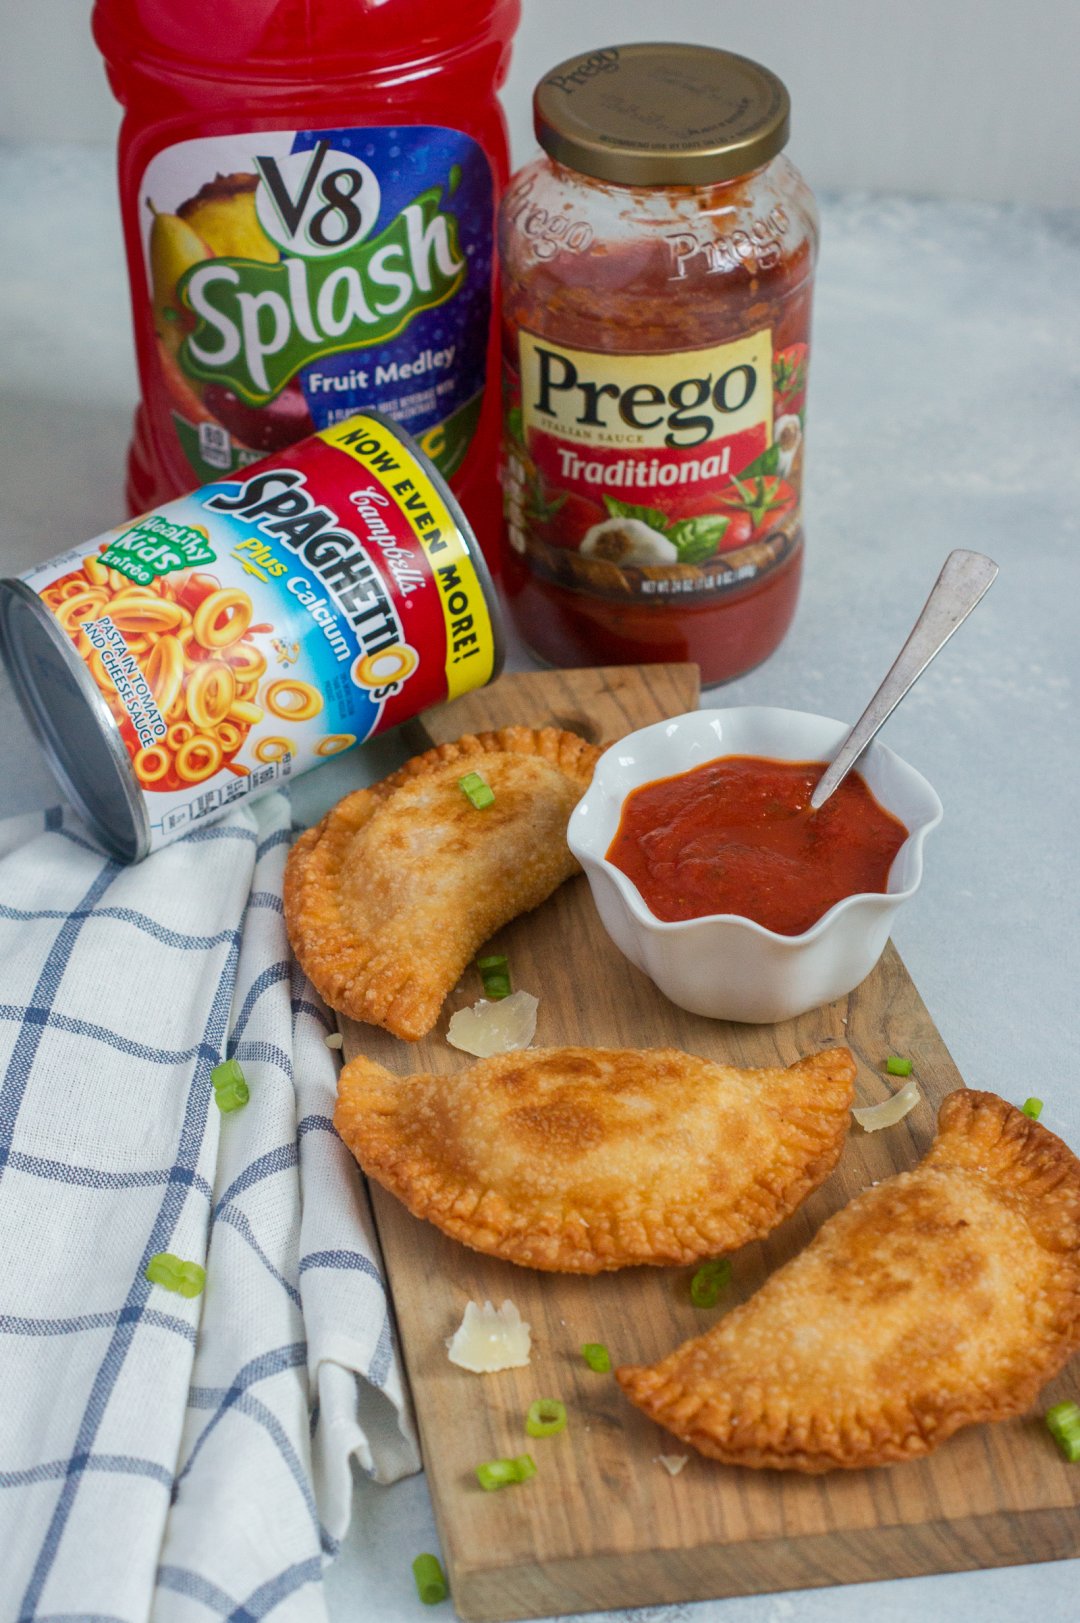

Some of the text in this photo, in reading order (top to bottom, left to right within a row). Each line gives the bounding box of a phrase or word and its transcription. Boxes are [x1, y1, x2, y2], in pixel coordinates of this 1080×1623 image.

[254, 140, 363, 247] V8
[187, 205, 464, 392] Splash
[309, 345, 455, 393] Fruit Medley
[533, 345, 757, 448] Prego
[542, 418, 644, 443] ITALIAN SAUCE
[557, 446, 731, 487] Traditional
[115, 531, 181, 570] Kids
[336, 428, 401, 473] NOW
[393, 479, 448, 554] EVEN
[438, 564, 480, 664] MORE!
[349, 486, 426, 598] Campbell's
[235, 538, 287, 577] Plus
[287, 577, 351, 661] Calcium
[82, 622, 154, 748] AND CHEESE SAUCE
[98, 617, 166, 736] PASTA IN TOMATO
